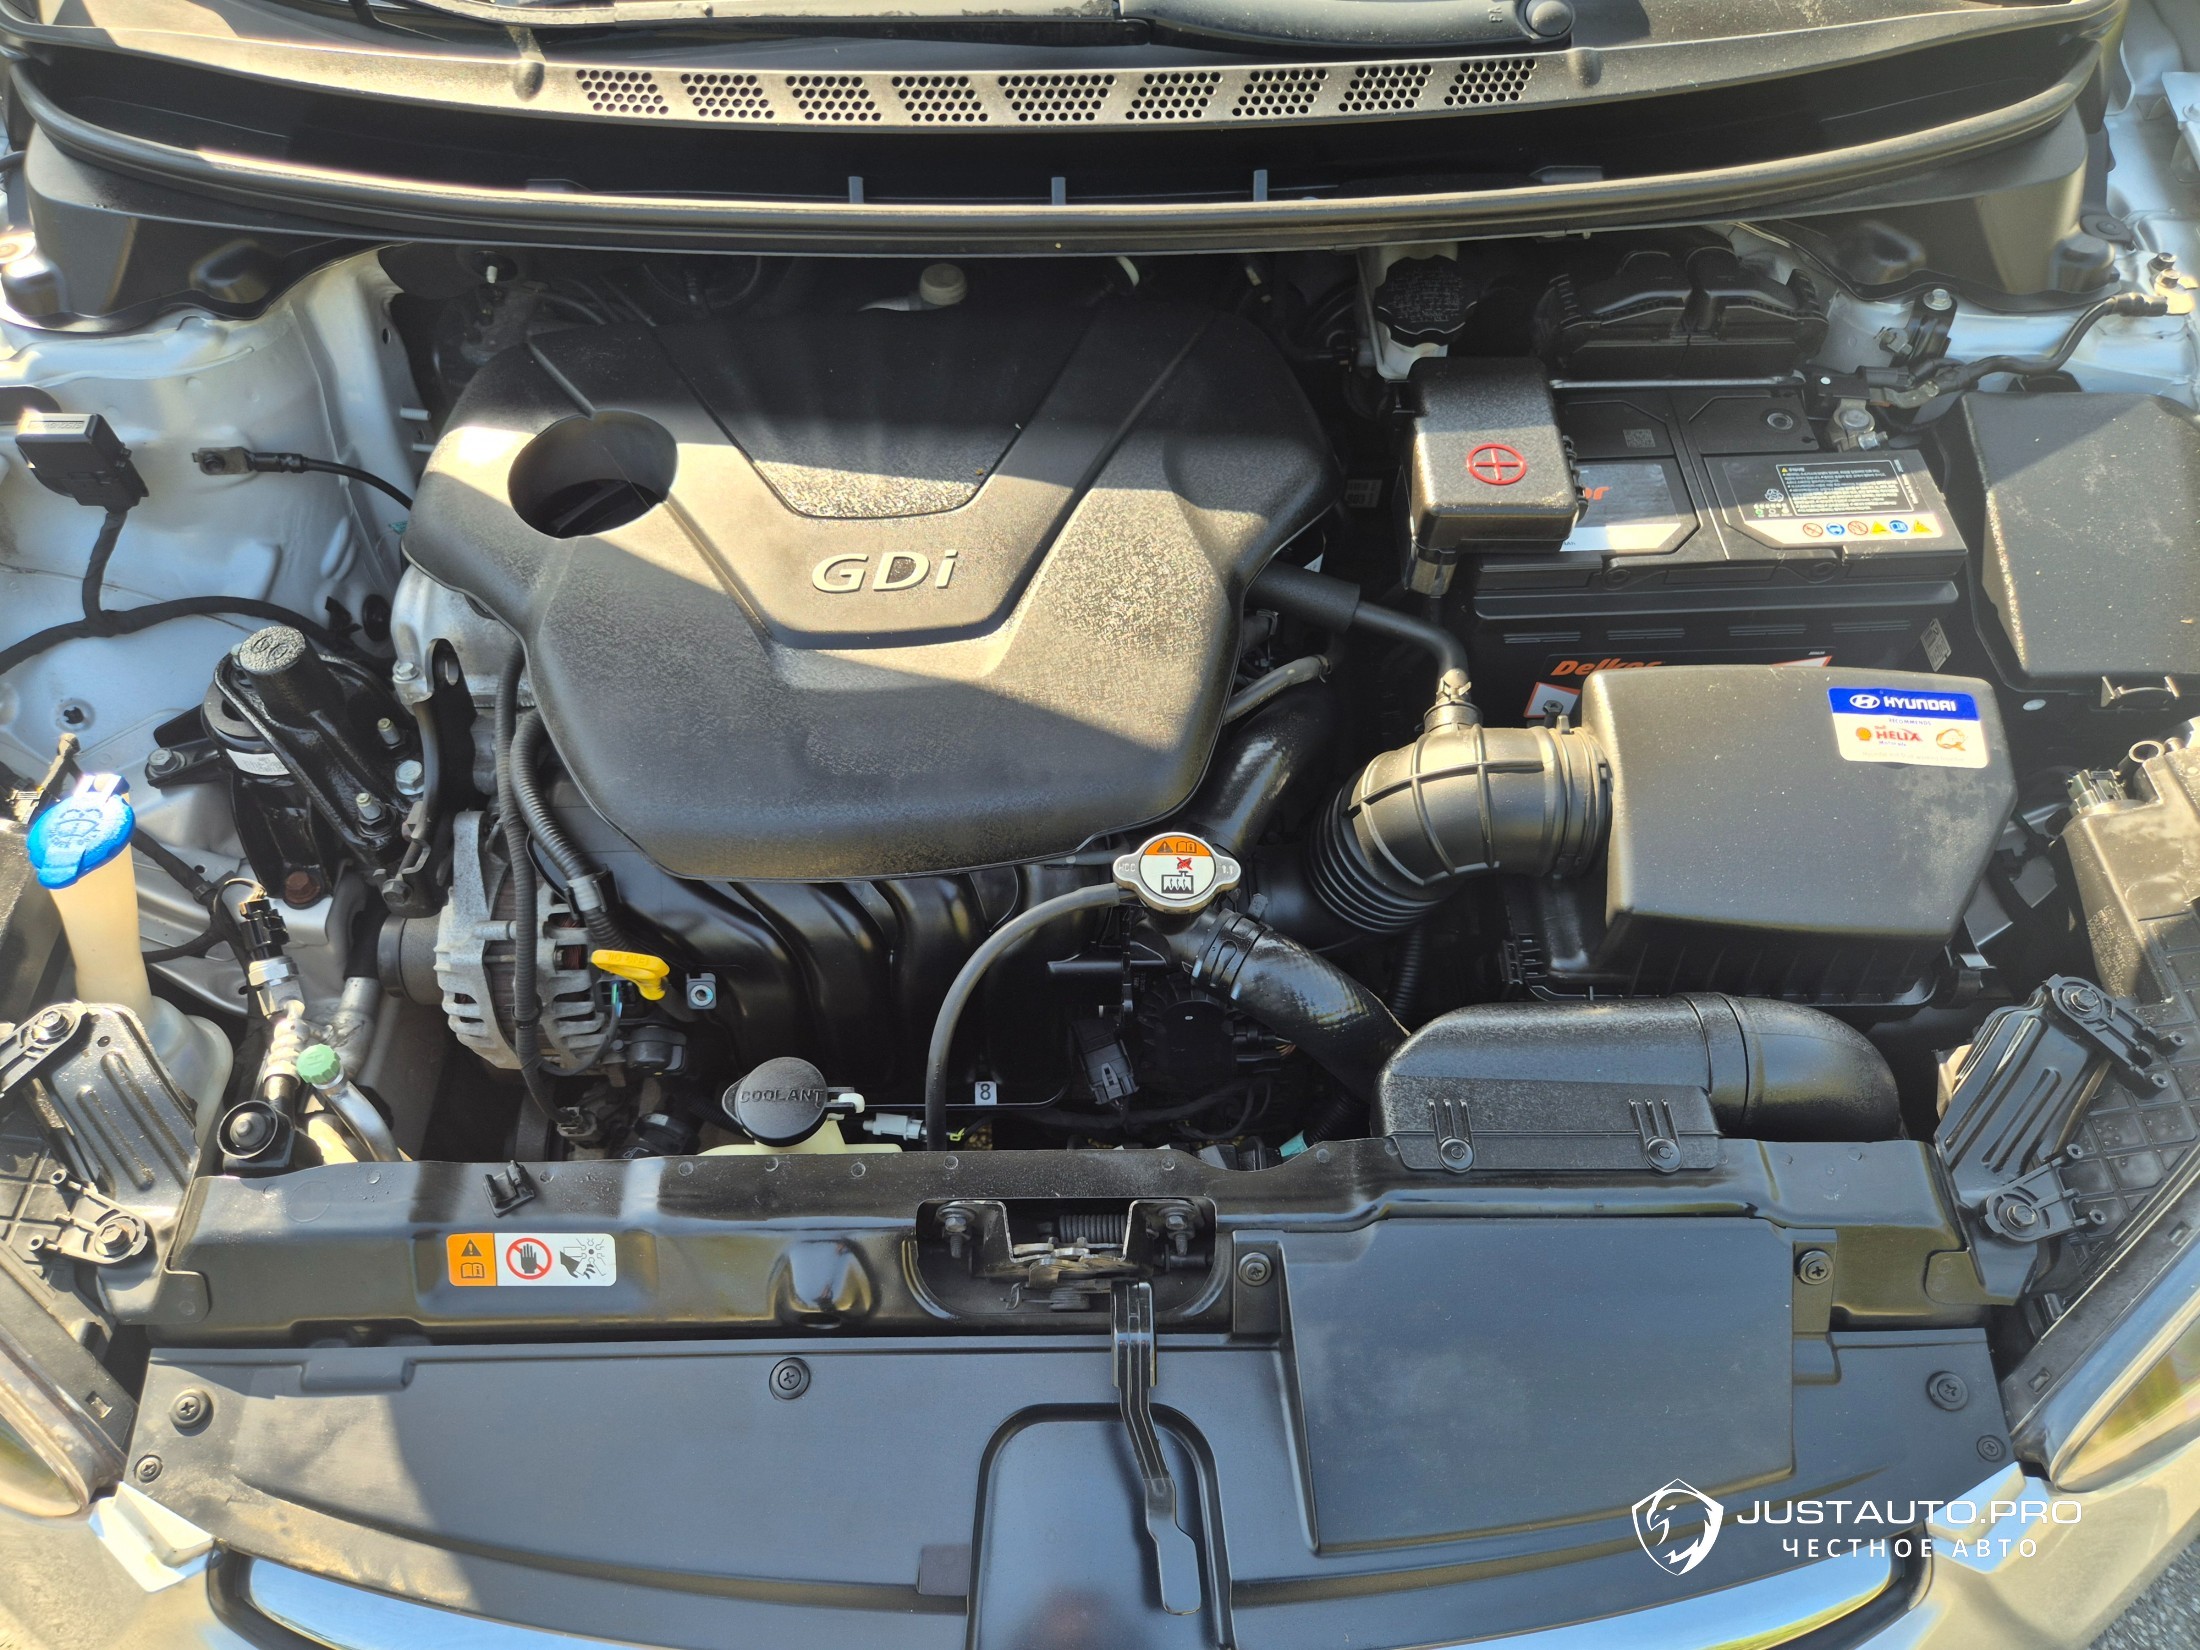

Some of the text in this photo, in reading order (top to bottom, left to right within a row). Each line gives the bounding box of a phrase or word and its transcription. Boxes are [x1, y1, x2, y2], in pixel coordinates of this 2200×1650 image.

[812, 550, 958, 594] GDi
[1883, 696, 1957, 711] HYUNDAI
[1876, 728, 1923, 742] HELIX
[741, 1088, 825, 1107] COOLANT
[980, 1083, 991, 1100] 8
